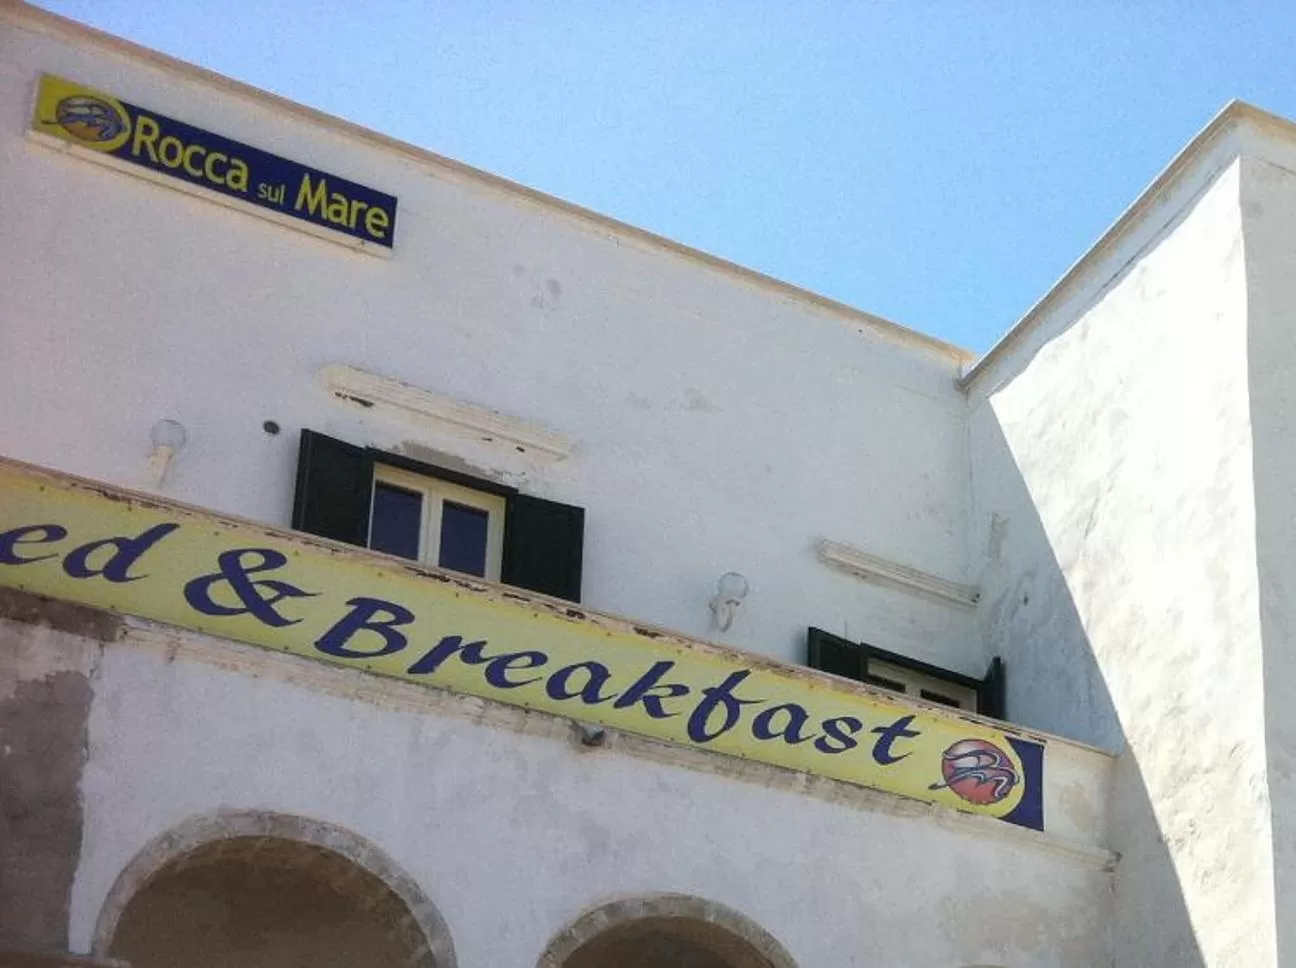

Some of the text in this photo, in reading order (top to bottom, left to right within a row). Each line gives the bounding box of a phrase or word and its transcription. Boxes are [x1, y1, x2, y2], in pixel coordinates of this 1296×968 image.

[132, 115, 390, 239] Rocca sul Mare
[183, 547, 324, 628] &
[313, 596, 922, 766] Breakfast
